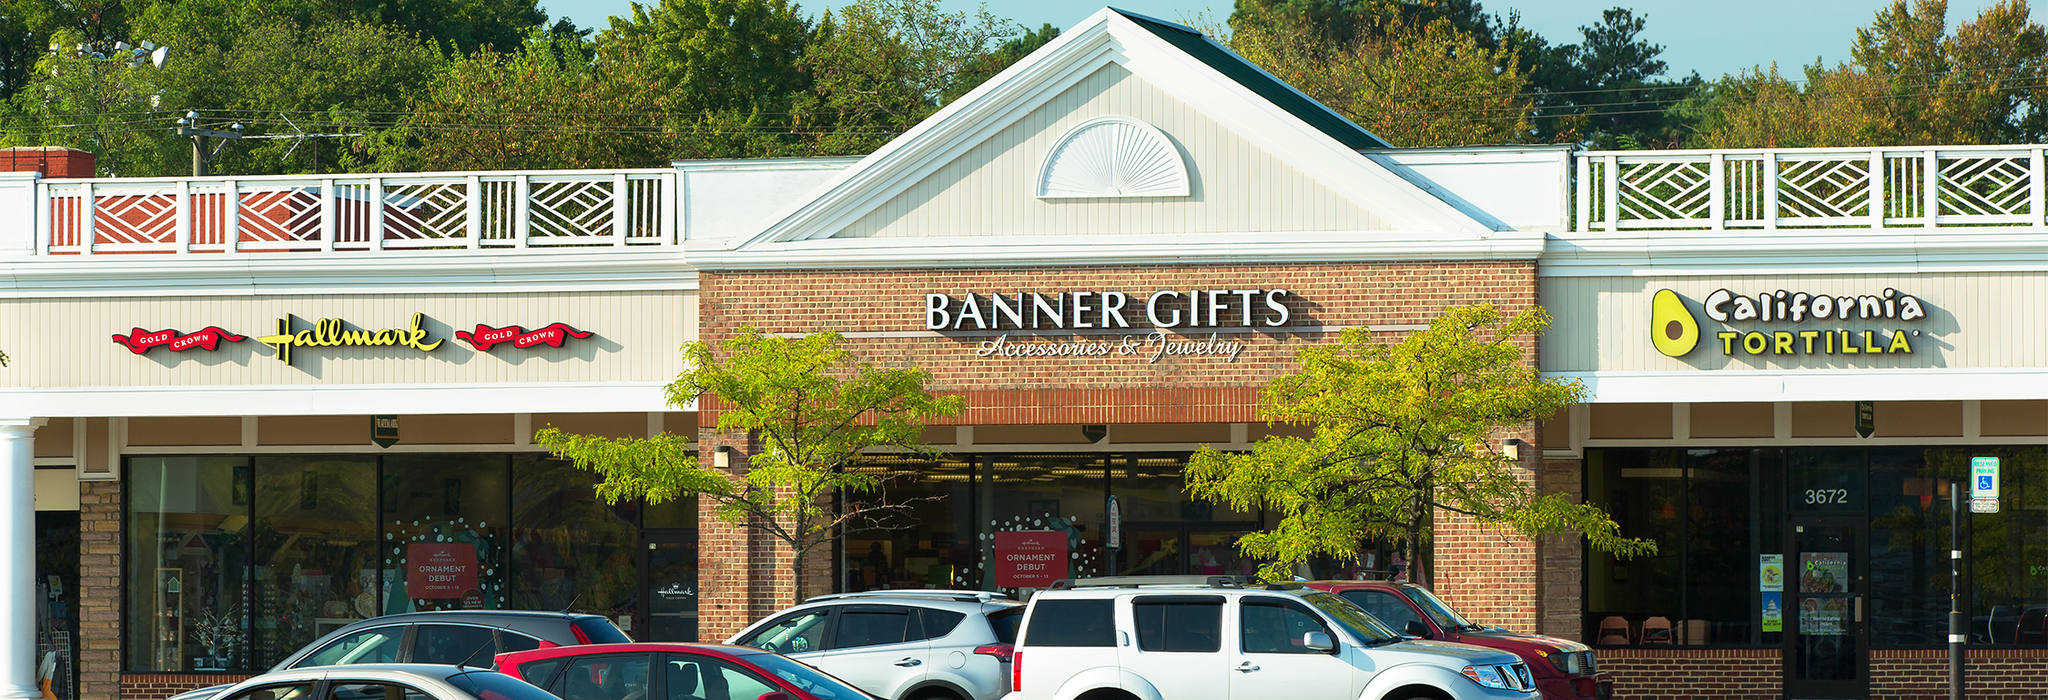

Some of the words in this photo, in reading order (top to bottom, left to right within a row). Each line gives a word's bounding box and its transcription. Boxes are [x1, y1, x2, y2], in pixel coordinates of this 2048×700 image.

[924, 291, 1130, 330] BANNER
[1146, 289, 1291, 328] GIFTS
[1704, 287, 1926, 323] California
[140, 333, 168, 344] GOLD
[173, 334, 209, 348] CROWN
[257, 312, 443, 366] Hallmark
[484, 330, 513, 341] GOLD
[519, 331, 555, 345] CROWN
[977, 334, 1112, 357] Accessories
[1118, 335, 1141, 355] &
[1146, 332, 1247, 363] Jewelry
[1717, 330, 1913, 355] TORTILLA
[1805, 489, 1848, 504] 3672
[1017, 563, 1046, 571] DEBUT
[657, 587, 694, 598] Hallmark
